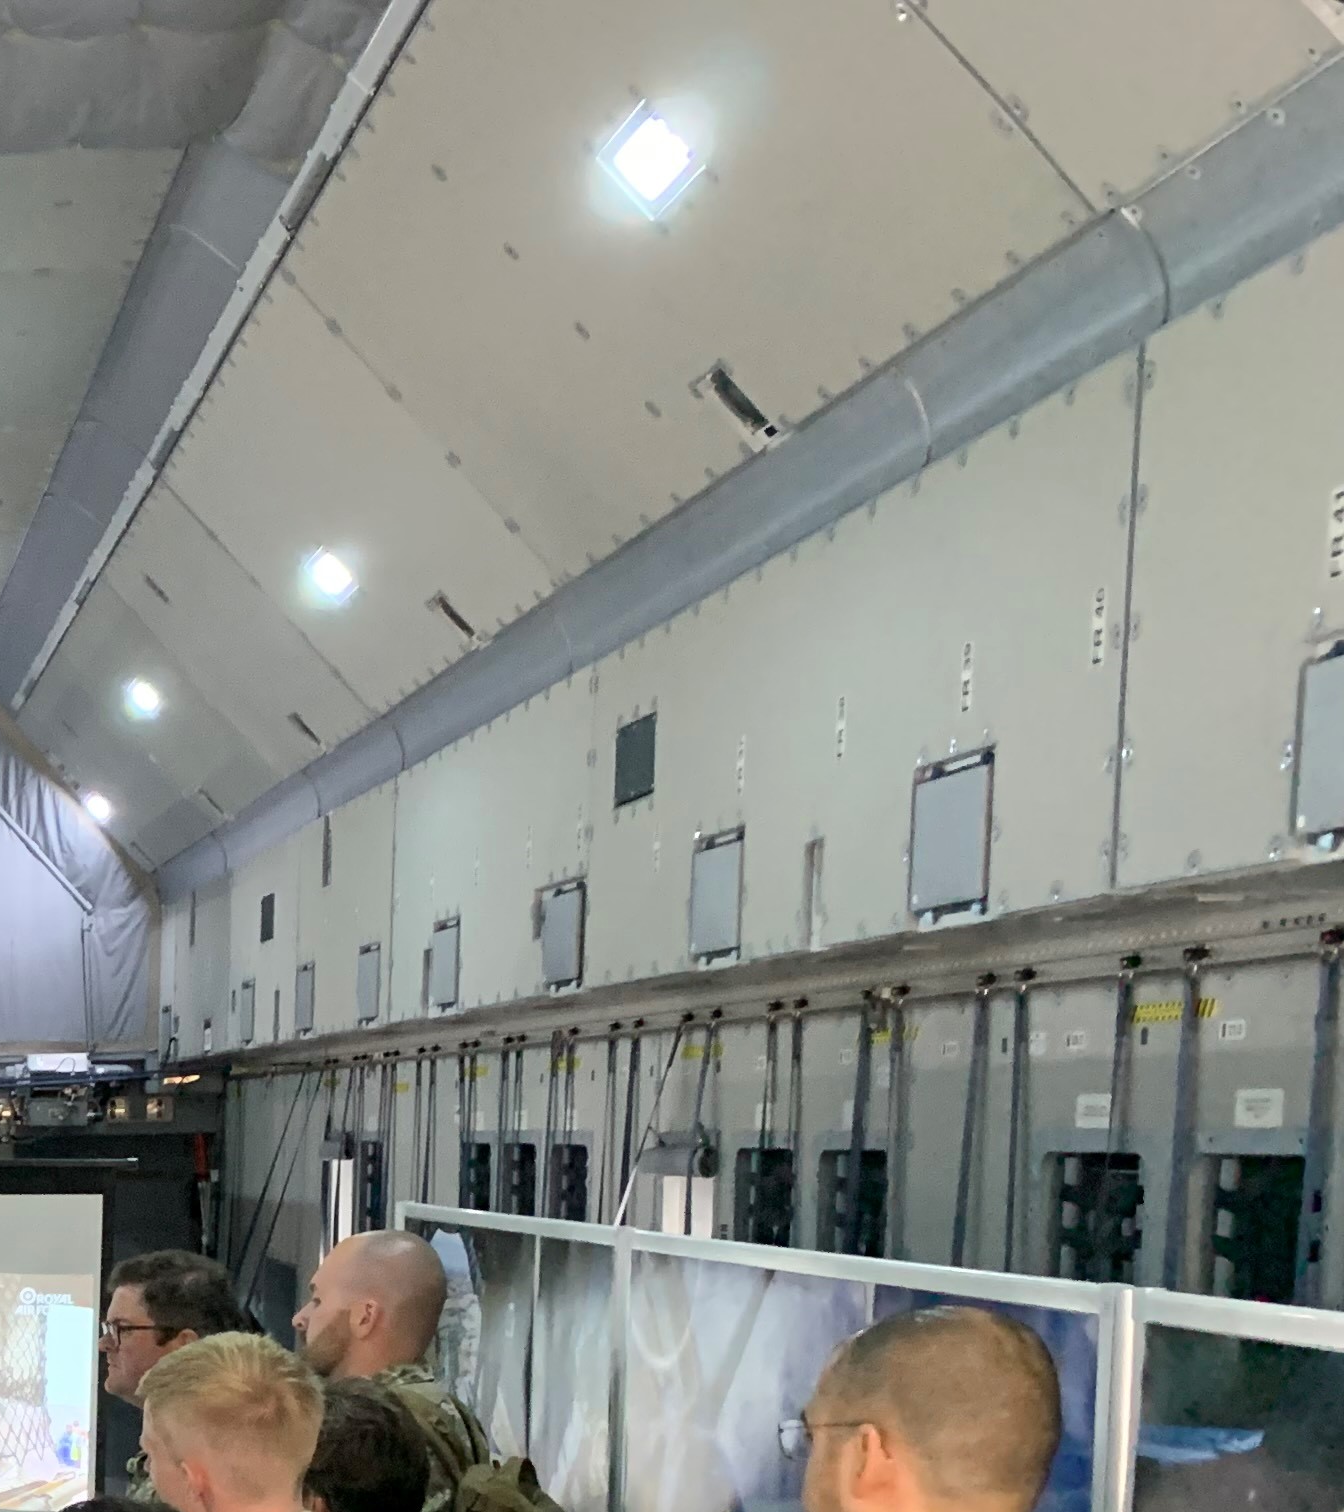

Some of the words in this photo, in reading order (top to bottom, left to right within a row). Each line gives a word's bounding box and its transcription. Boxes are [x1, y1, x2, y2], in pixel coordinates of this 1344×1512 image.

[1095, 587, 1105, 618] 40
[1092, 627, 1103, 665] FR
[36, 1292, 74, 1305] ROYAL
[15, 1305, 35, 1316] AIR
